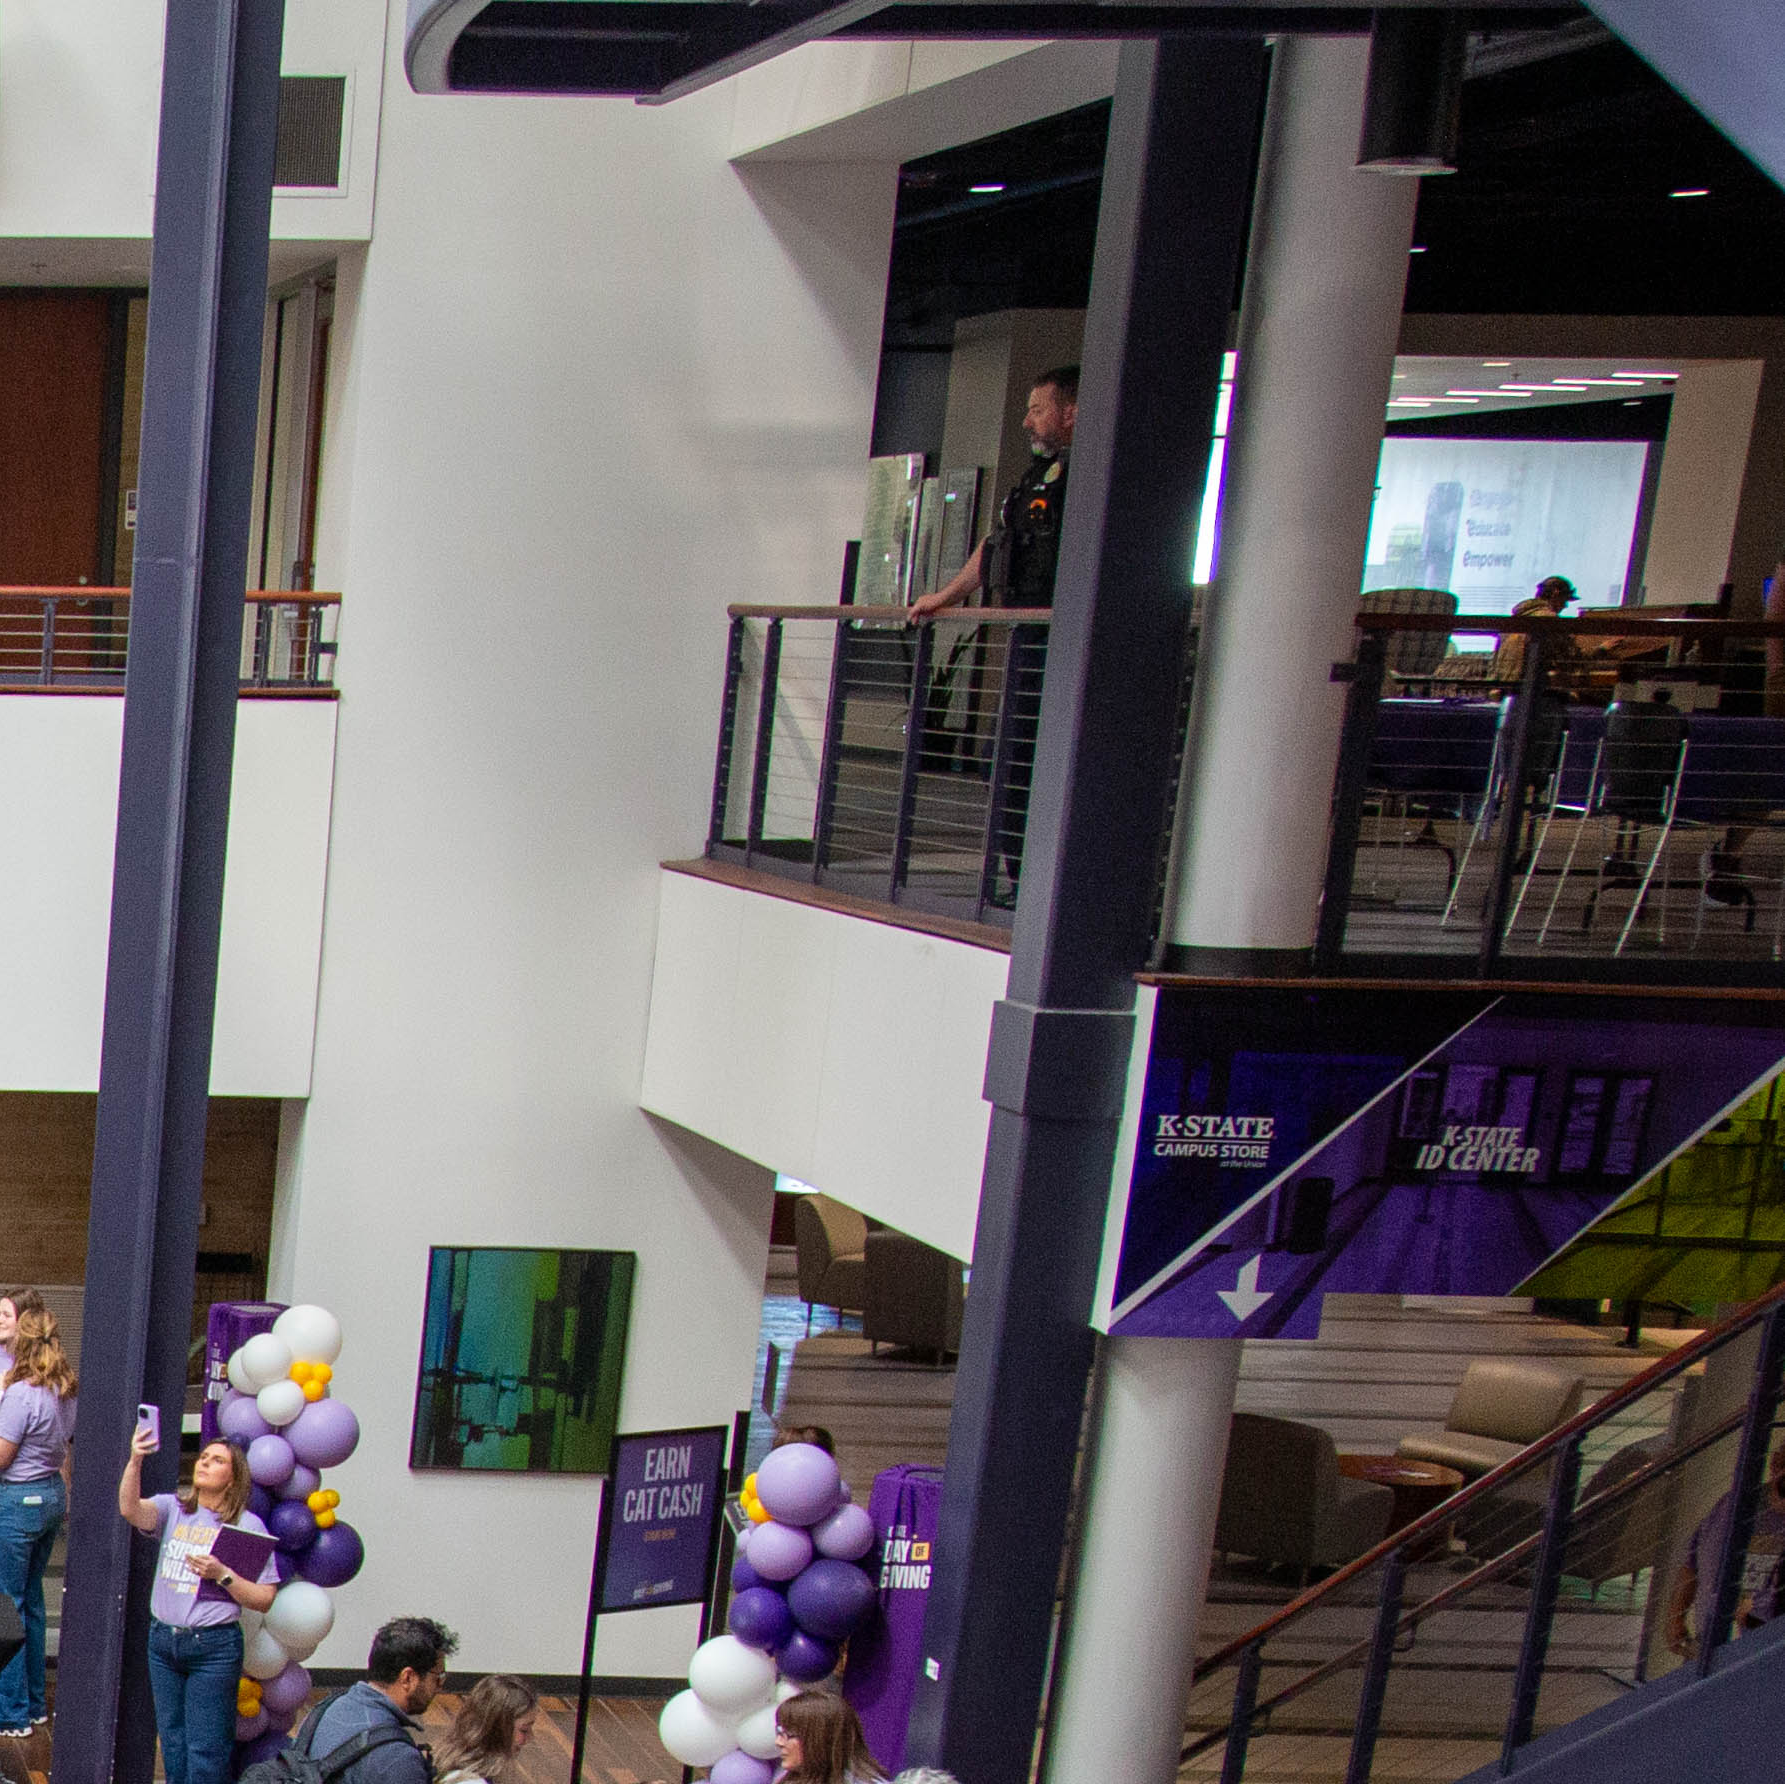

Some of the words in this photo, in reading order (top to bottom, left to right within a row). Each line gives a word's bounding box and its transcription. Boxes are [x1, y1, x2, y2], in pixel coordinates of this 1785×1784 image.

[1154, 1142, 1219, 1158] CAMPUS
[1220, 1143, 1269, 1160] STORE
[1440, 1125, 1524, 1149] K-STATE
[1415, 1144, 1446, 1171] ID
[1448, 1146, 1541, 1173] CENTER
[644, 1446, 692, 1483] EARN
[623, 1486, 656, 1523] CAT
[659, 1483, 703, 1517] CASH
